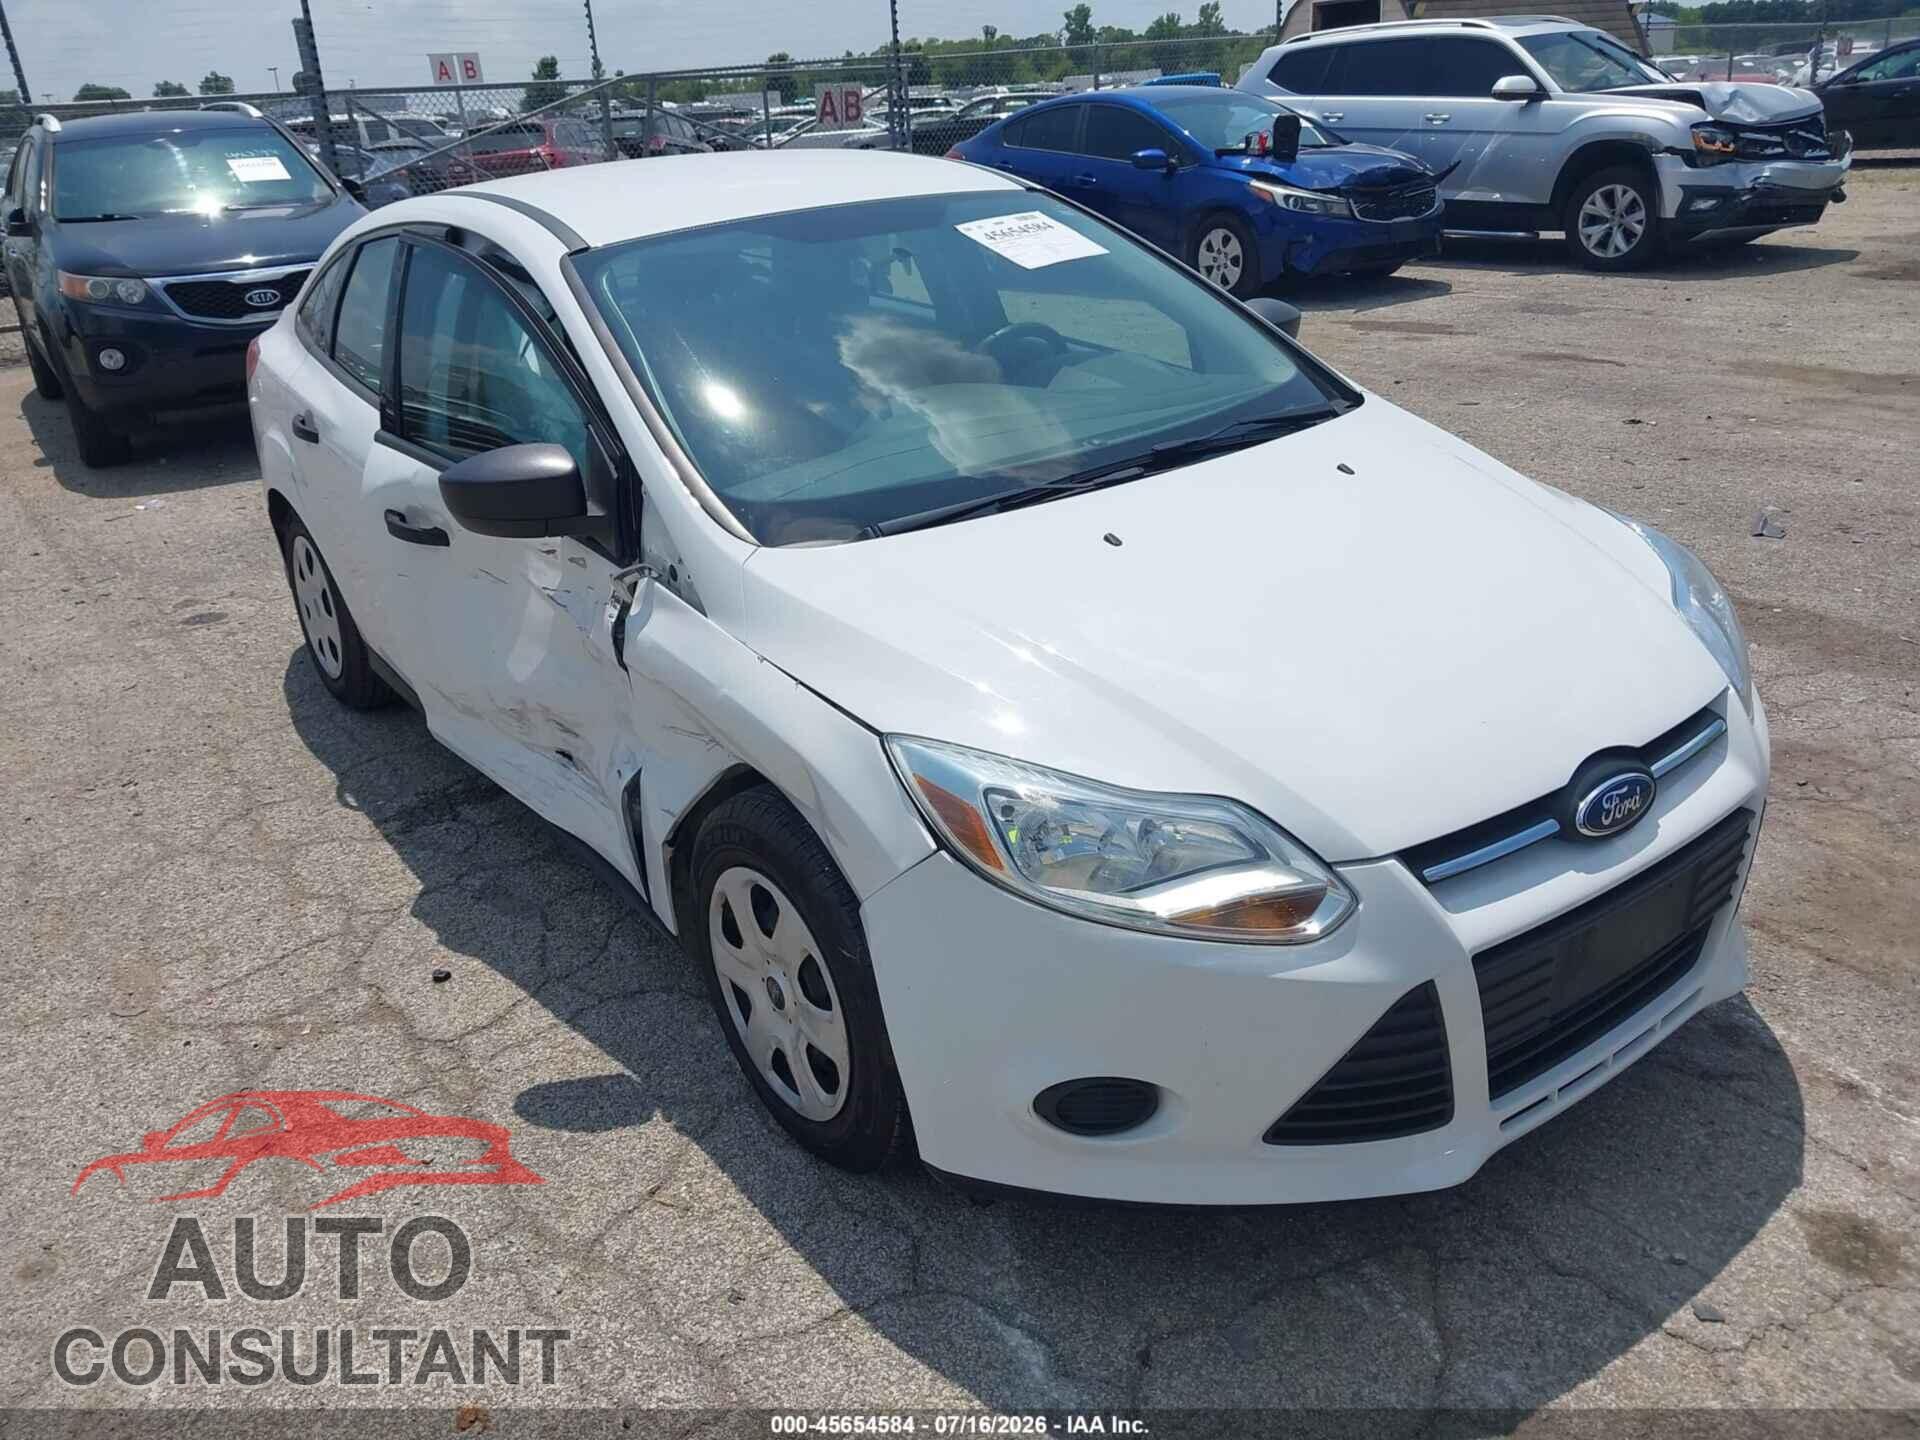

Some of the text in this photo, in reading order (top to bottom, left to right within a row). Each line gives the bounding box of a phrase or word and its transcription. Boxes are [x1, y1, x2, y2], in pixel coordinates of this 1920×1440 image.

[438, 60, 478, 81] A B
[819, 90, 862, 123] A B
[1601, 785, 1641, 825] Ford
